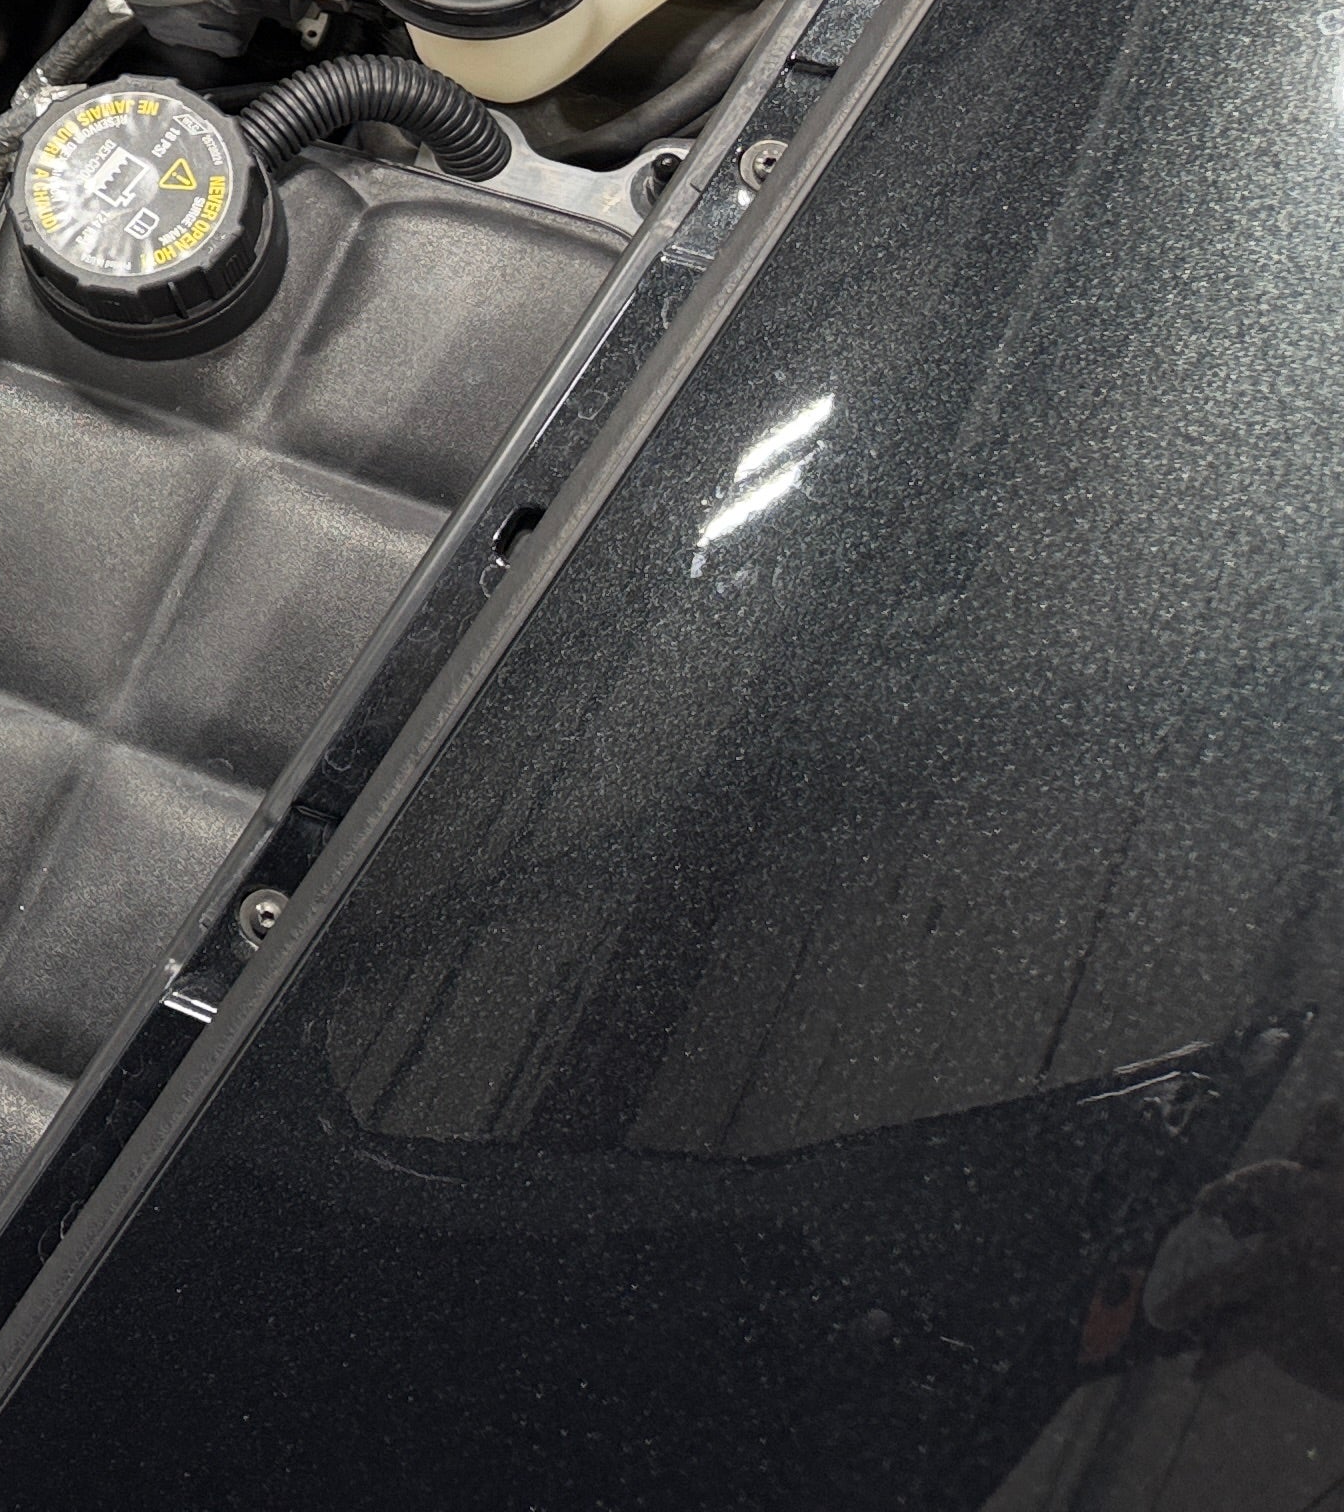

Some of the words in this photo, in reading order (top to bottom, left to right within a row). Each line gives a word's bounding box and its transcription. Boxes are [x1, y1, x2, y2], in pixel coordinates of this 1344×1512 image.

[75, 99, 136, 128] JAMAIS
[137, 98, 160, 117] NE
[38, 119, 80, 165] OUVR
[151, 138, 172, 158] PSI
[164, 127, 181, 142] 18
[180, 196, 206, 228] SURGE
[200, 175, 226, 222] NEVER
[158, 224, 188, 246] TANK
[174, 219, 211, 252] OPEN
